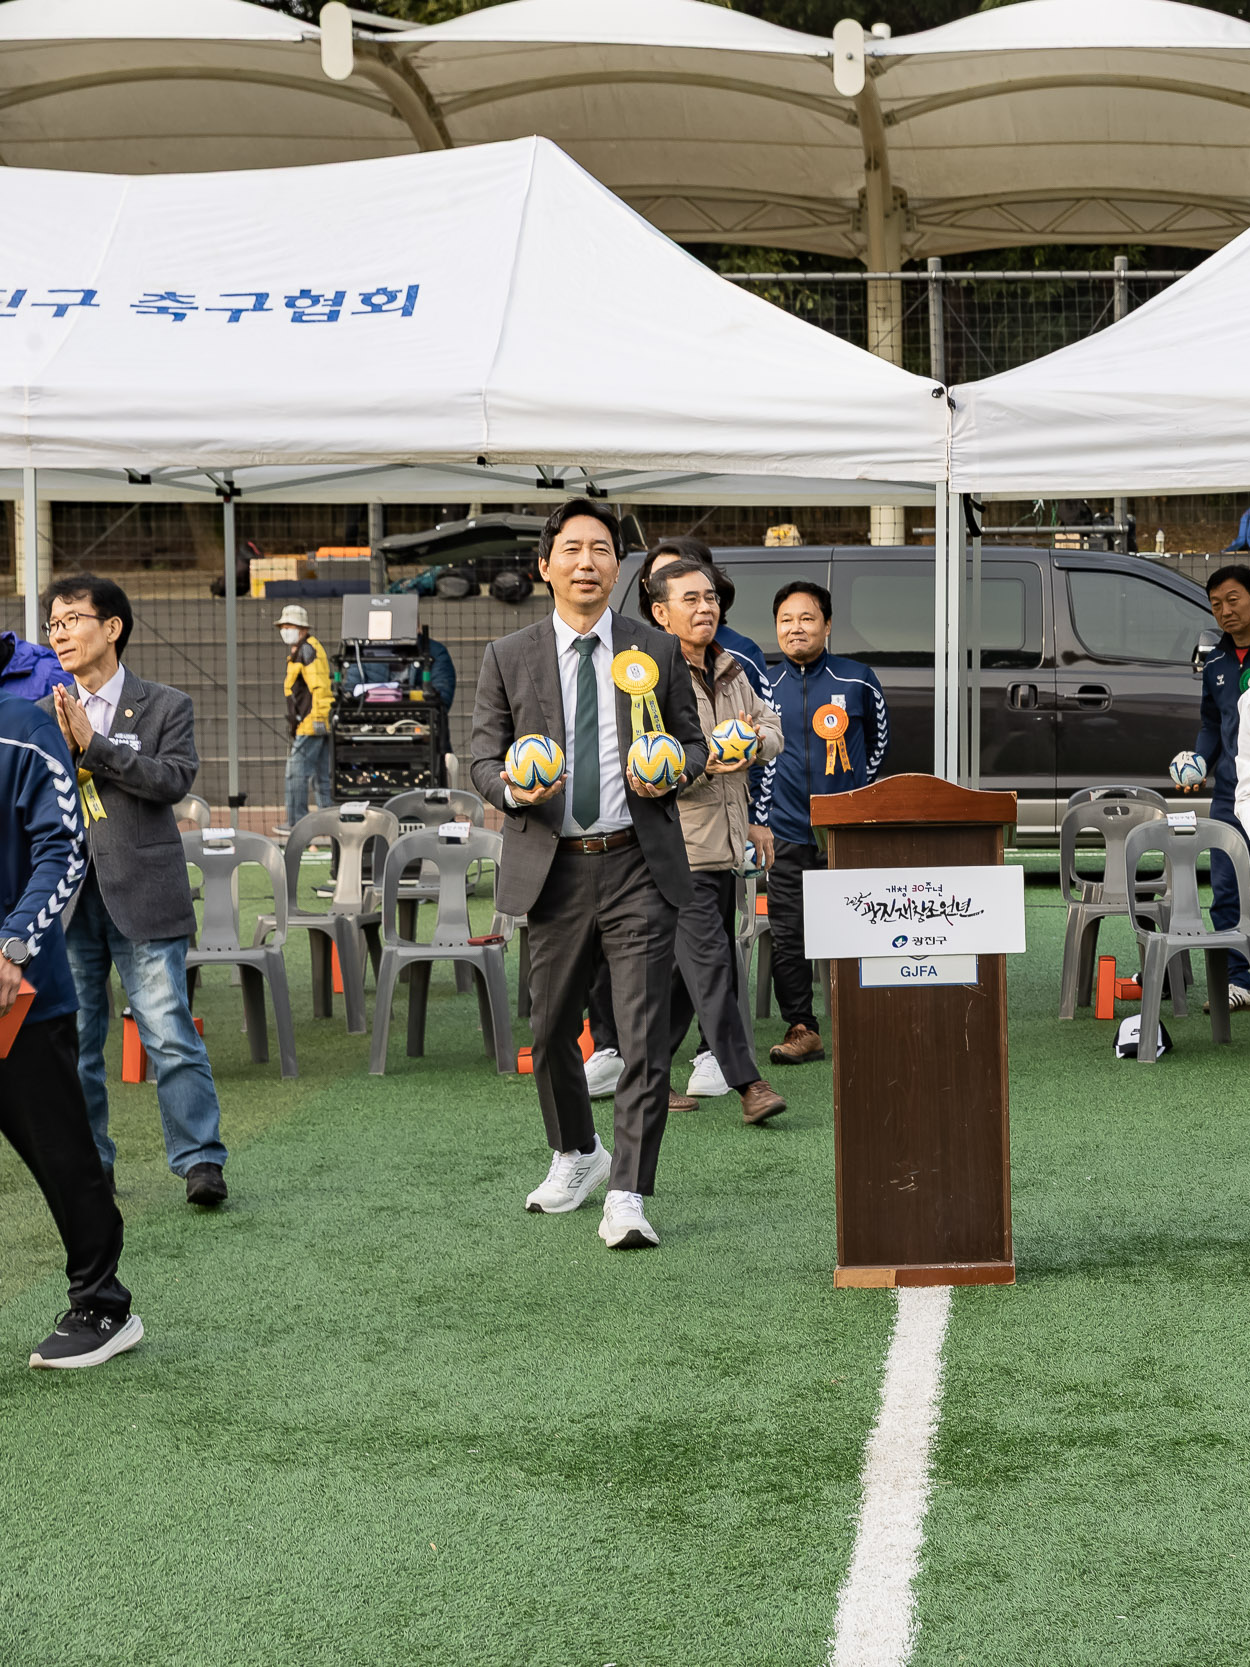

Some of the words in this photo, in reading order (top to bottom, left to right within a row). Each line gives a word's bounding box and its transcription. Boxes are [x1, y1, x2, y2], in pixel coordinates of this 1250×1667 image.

[130, 284, 420, 324] 축구협회
[885, 885, 908, 897] 개청
[911, 881, 943, 897] 30주년
[911, 935, 948, 946] 광진구
[900, 965, 938, 978] GJFA
